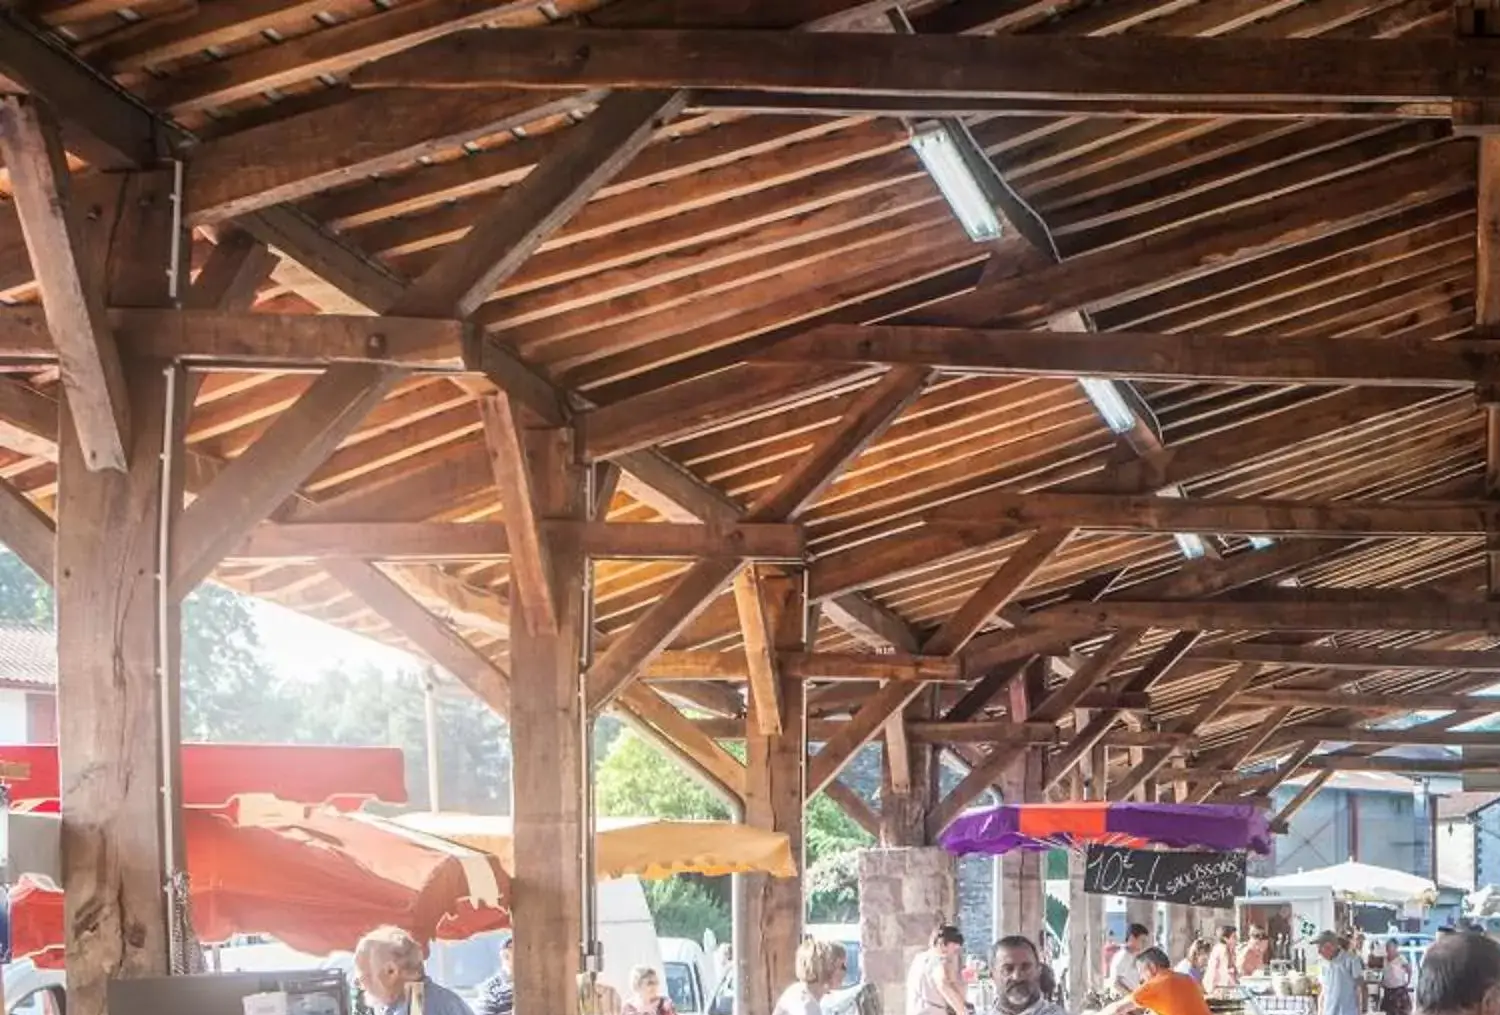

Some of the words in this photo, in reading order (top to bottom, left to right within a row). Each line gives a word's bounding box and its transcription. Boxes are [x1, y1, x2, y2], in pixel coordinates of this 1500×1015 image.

[1117, 877, 1145, 895] LES
[1145, 854, 1166, 900] 4
[1189, 884, 1234, 905] CHOIX
